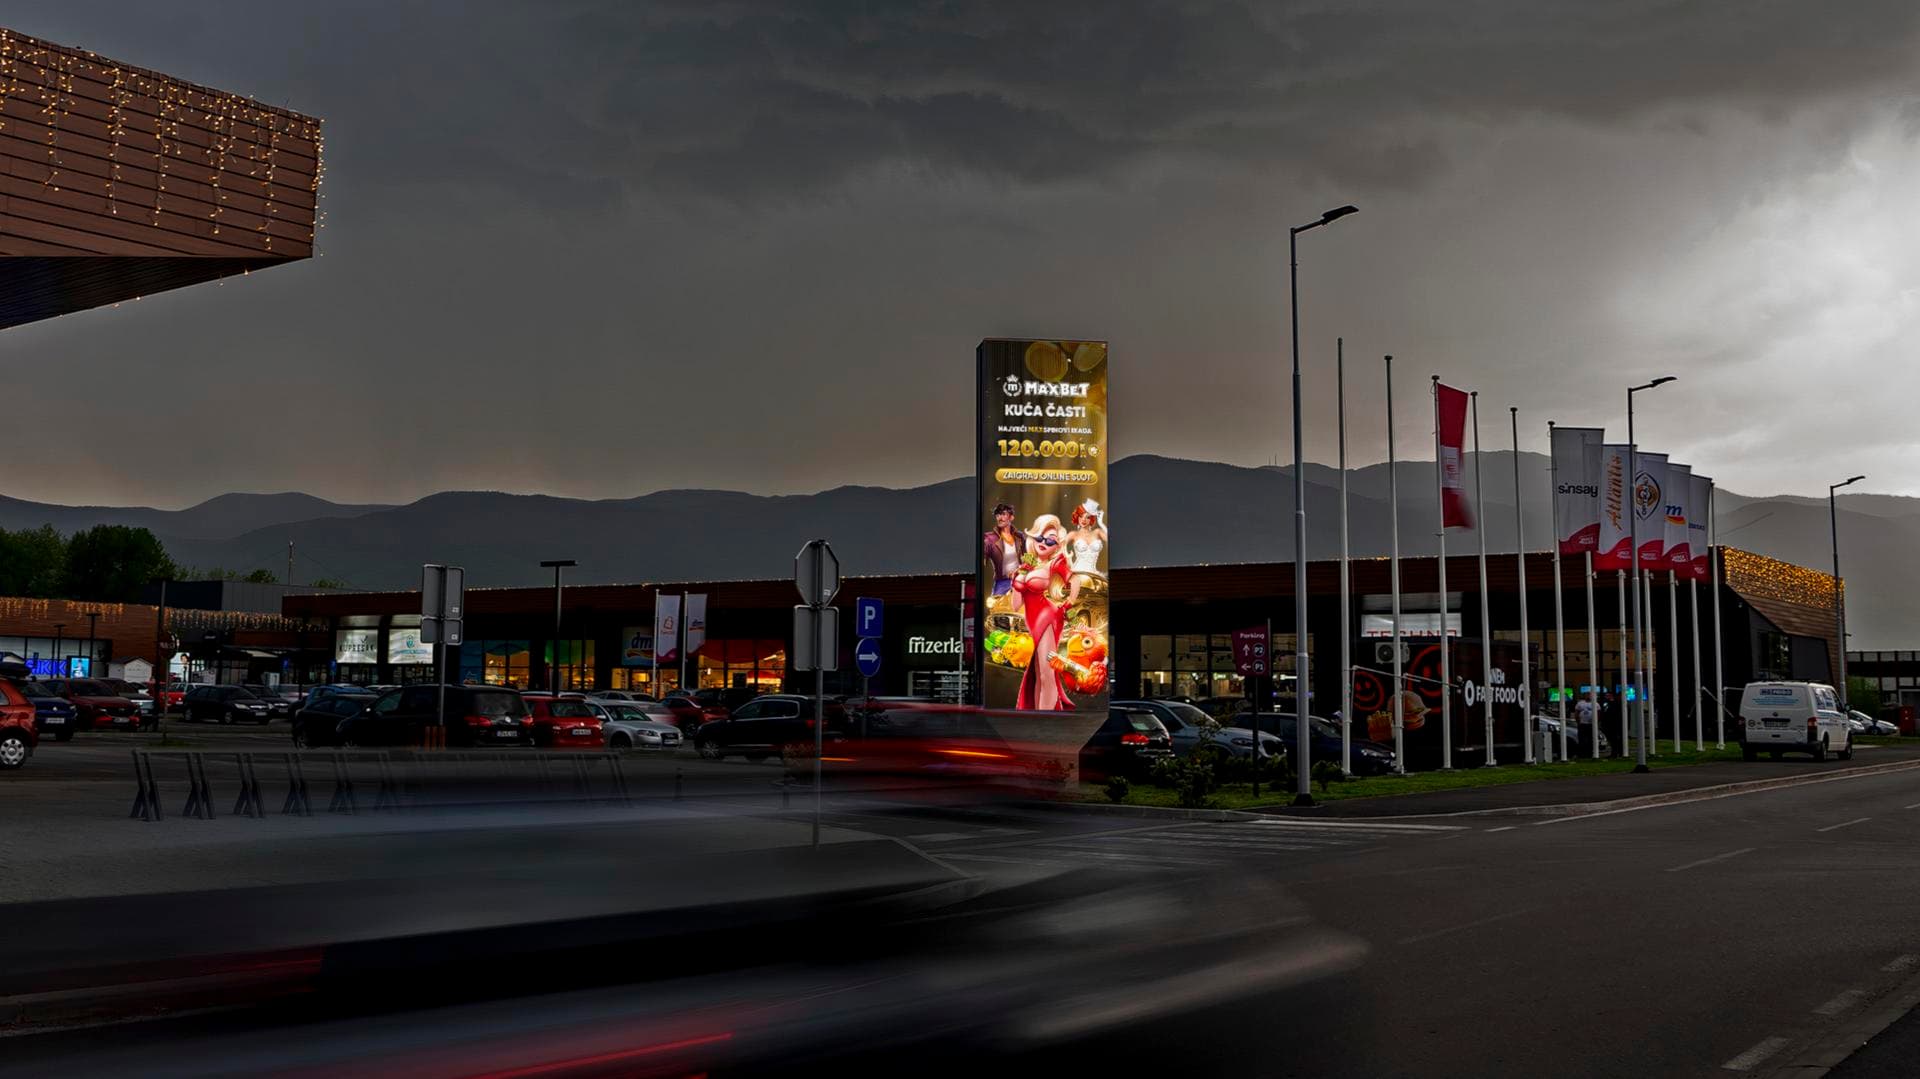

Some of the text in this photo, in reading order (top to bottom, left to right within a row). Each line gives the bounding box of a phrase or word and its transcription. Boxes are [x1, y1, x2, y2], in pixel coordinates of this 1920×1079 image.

[1024, 381, 1090, 398] MAXBET
[1004, 401, 1086, 418] KUĆA ČASTI
[997, 439, 1079, 458] 120.000
[1003, 471, 1091, 482] ZAIGRAJ ONLINE SLOT
[1558, 482, 1598, 498] sinsay
[864, 605, 876, 630] P
[631, 631, 653, 649] dm
[1239, 632, 1265, 640] Parking
[1476, 685, 1517, 704] FAT FOOD
